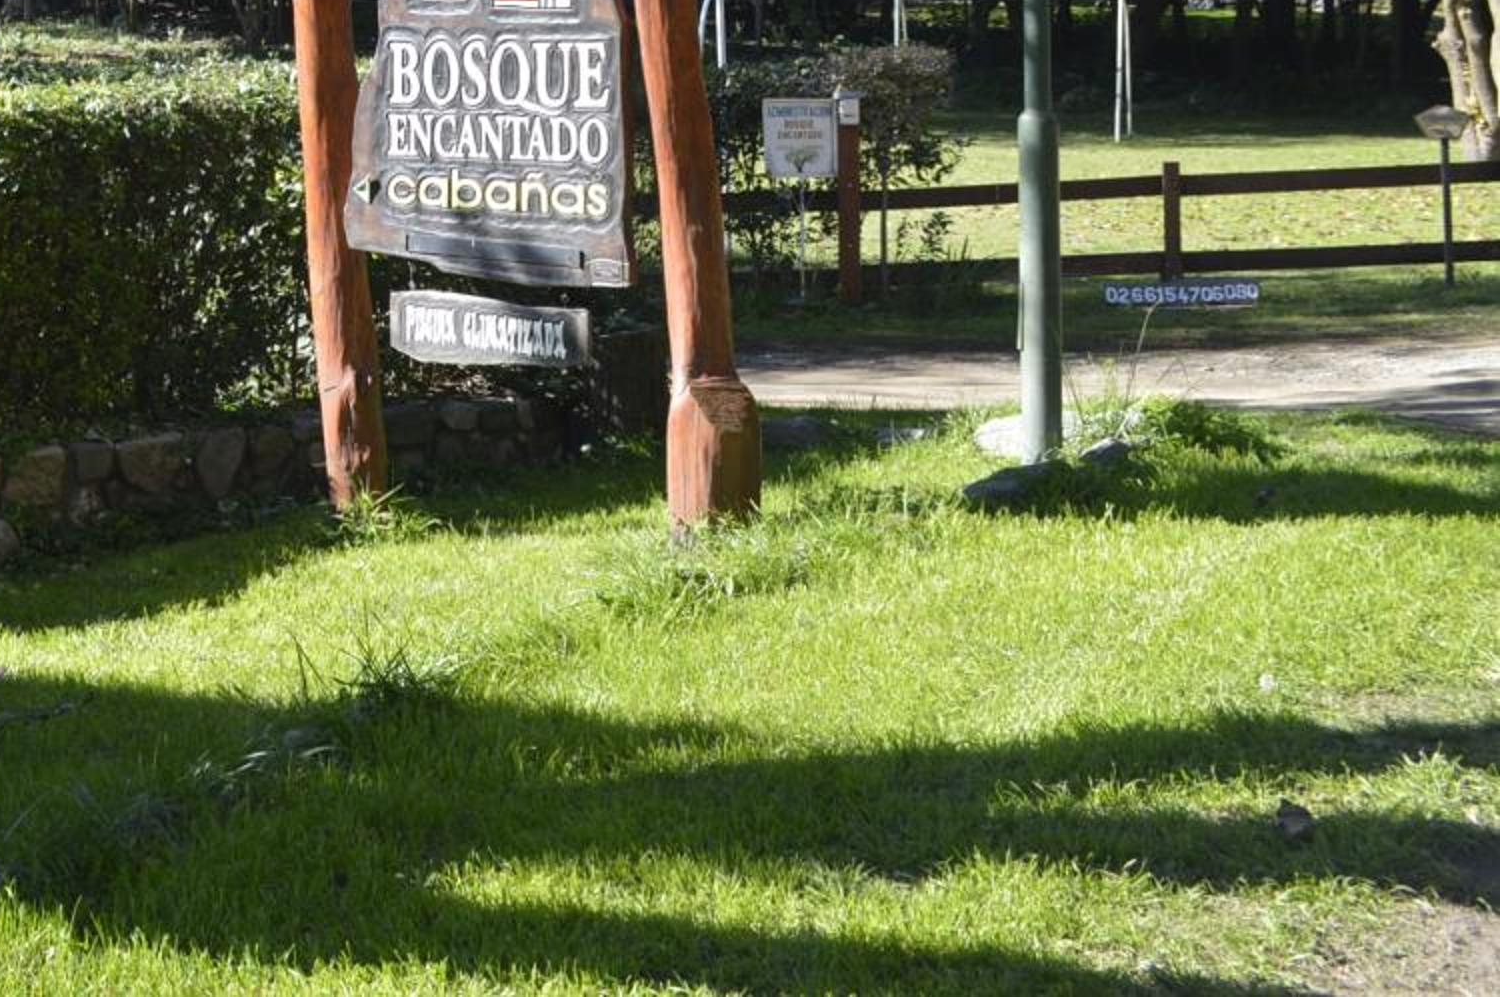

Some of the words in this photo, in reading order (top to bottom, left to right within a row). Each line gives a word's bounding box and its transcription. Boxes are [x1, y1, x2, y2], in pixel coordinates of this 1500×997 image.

[389, 40, 610, 115] BOSQUE
[387, 113, 609, 164] ENCANTADO
[387, 169, 608, 217] cabañas
